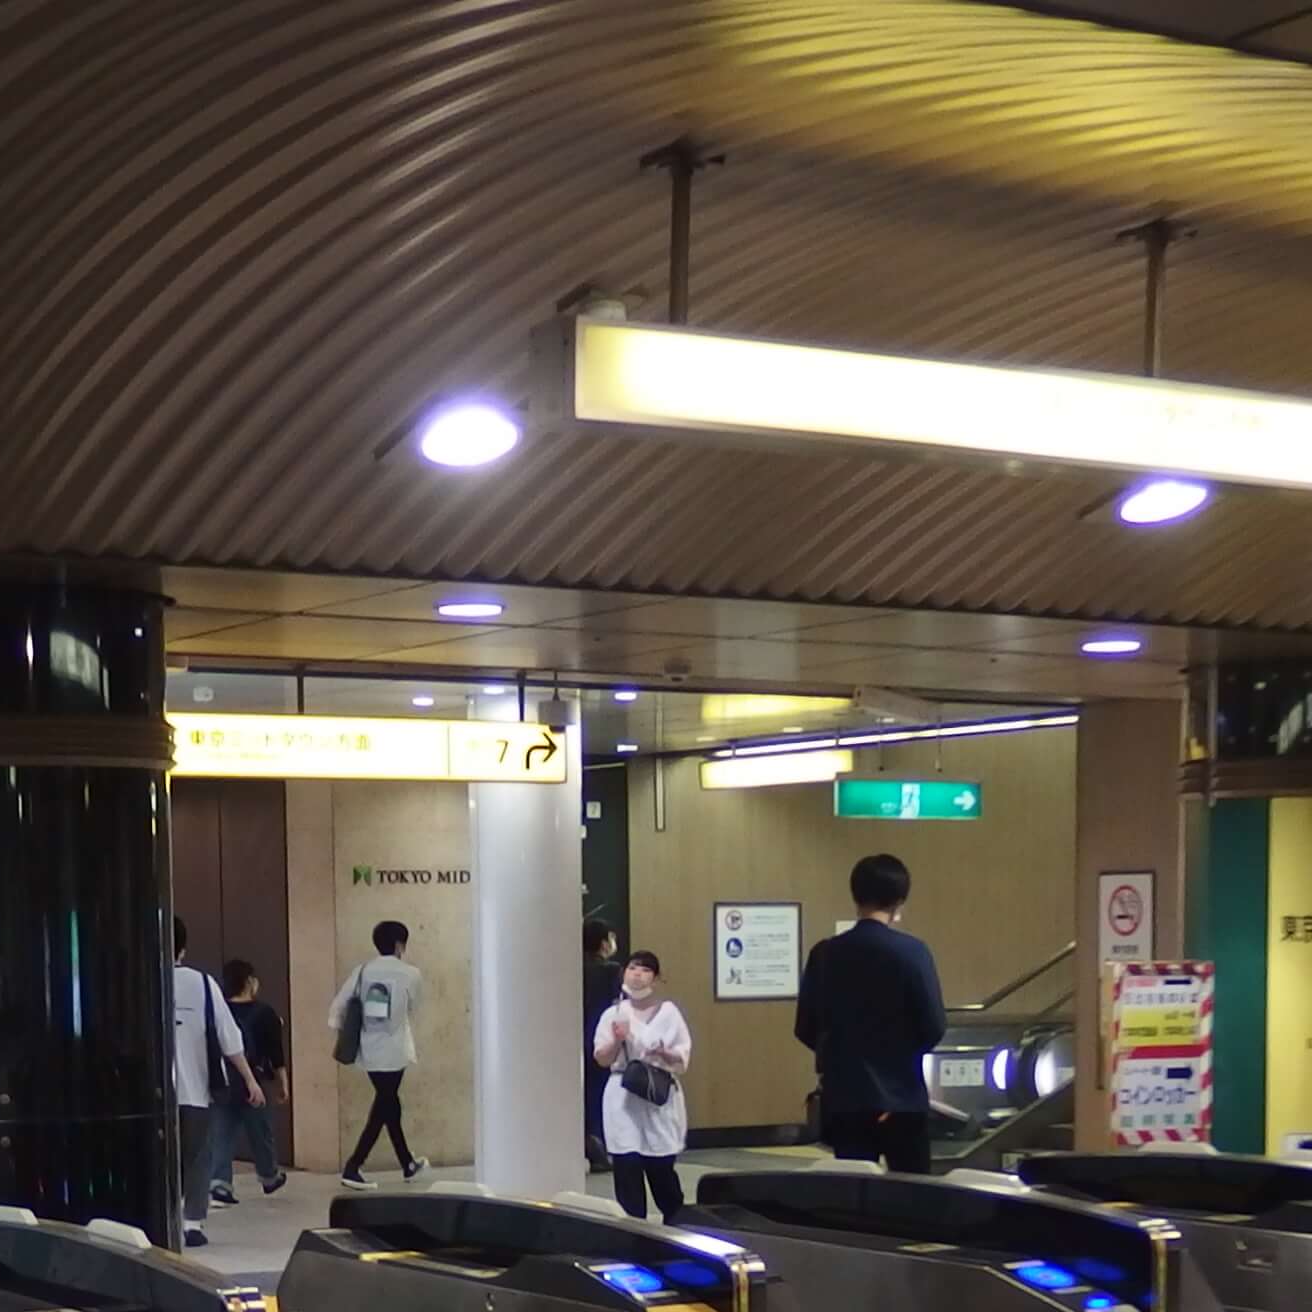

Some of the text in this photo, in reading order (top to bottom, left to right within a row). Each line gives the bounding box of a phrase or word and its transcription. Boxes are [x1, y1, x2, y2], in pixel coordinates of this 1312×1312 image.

[496, 739, 509, 764] 7
[376, 869, 472, 884] TOKYO MID
